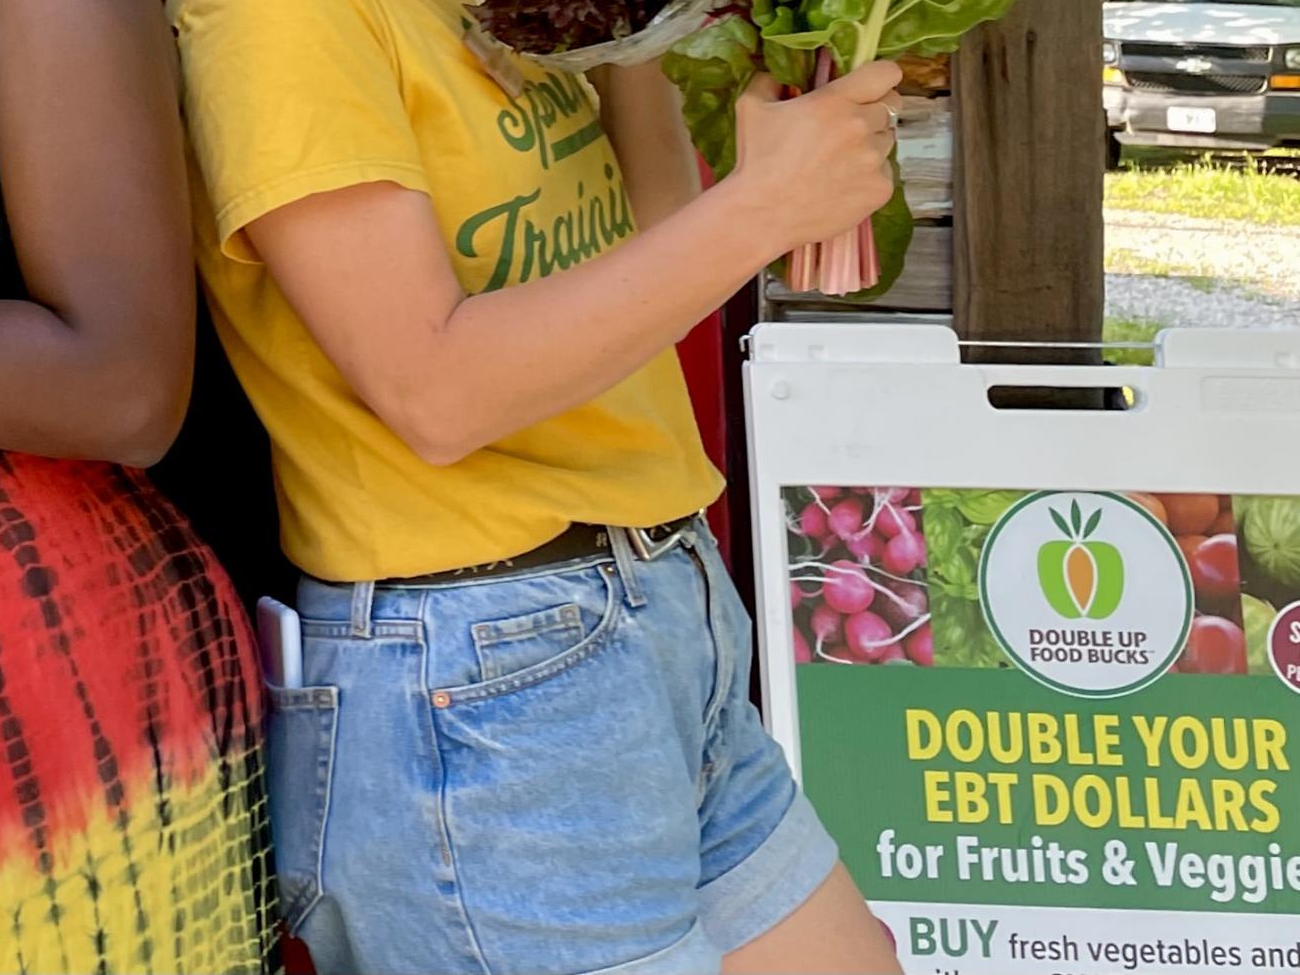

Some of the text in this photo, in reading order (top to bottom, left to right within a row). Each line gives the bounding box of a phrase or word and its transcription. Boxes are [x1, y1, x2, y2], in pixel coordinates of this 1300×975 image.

[456, 163, 633, 292] Traini
[1028, 629, 1147, 647] DOUBLE UP
[1030, 647, 1149, 665] FOOD BUCKS
[905, 709, 1289, 770] DOUBLE YOUR
[923, 770, 1281, 833] EBT DOLLARS
[876, 830, 944, 879] for
[956, 836, 1089, 885] Fruits
[1101, 839, 1137, 888] &
[908, 917, 1300, 970] BUY fresh vegetables and
